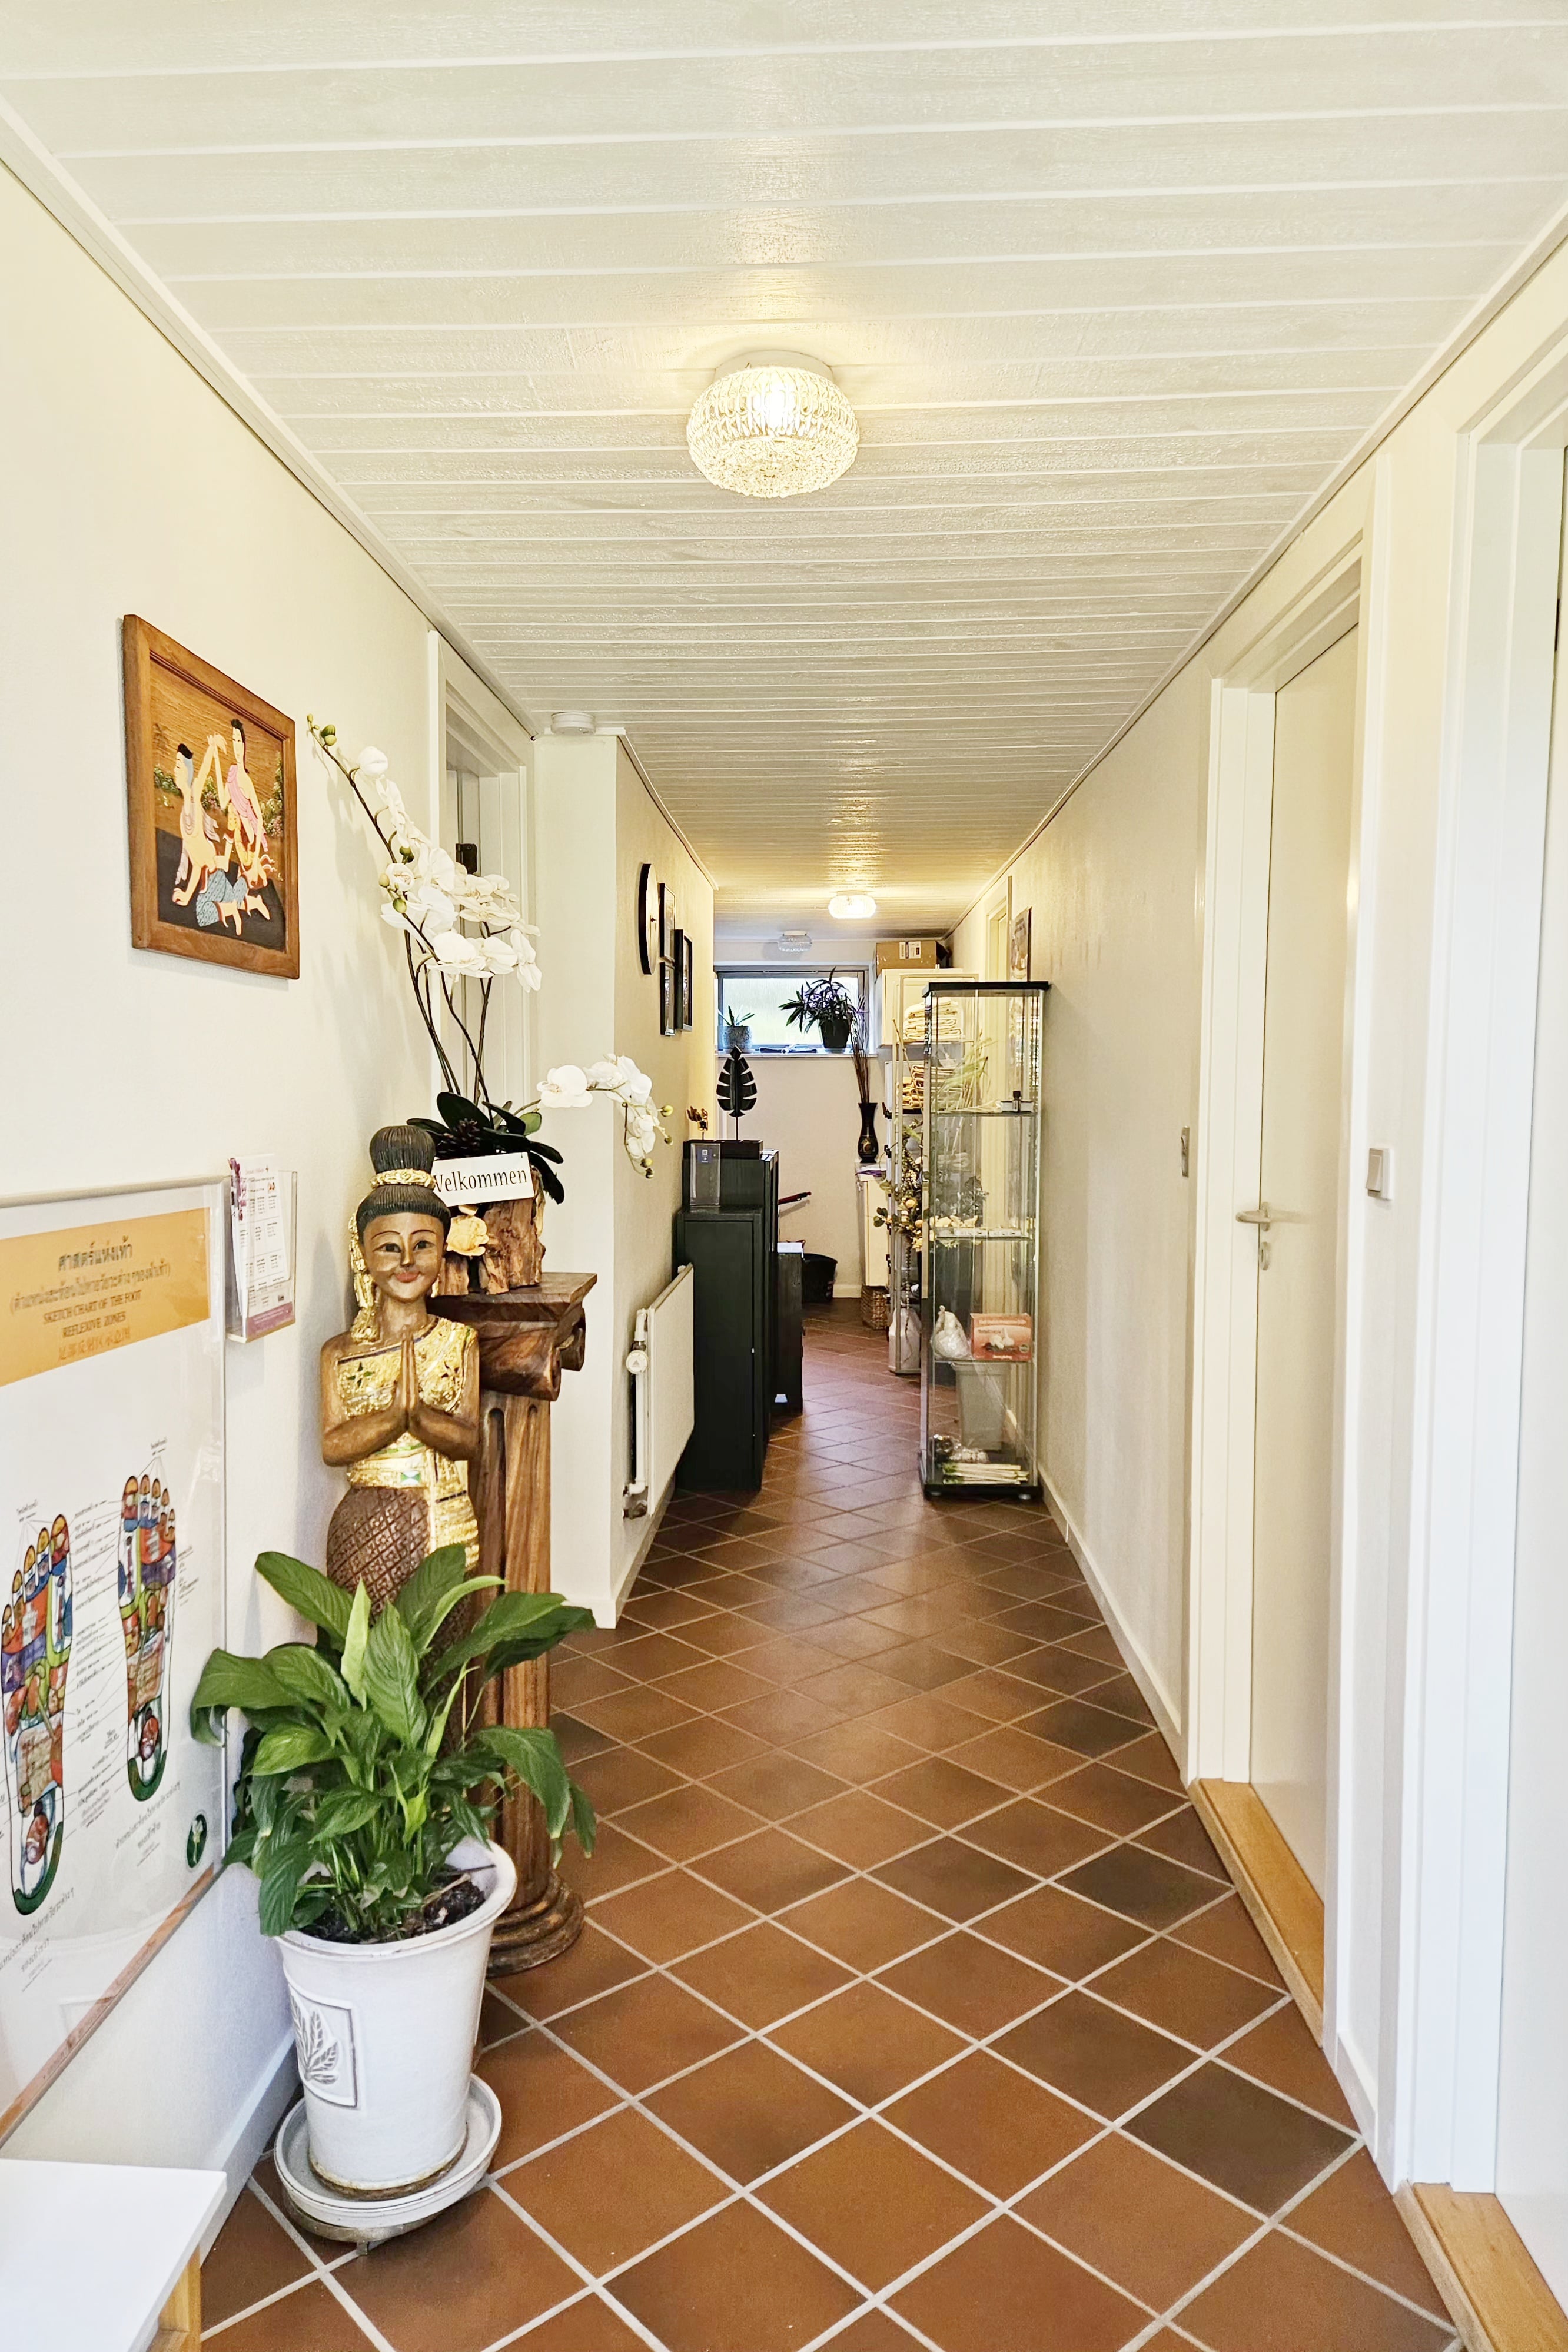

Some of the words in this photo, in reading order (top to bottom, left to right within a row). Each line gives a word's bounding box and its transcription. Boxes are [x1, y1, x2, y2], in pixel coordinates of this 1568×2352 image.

[433, 1170, 527, 1192] Velkommen
[44, 1307, 72, 1324] SKETCH
[74, 1301, 97, 1316] CHART
[98, 1298, 108, 1310] OF
[110, 1294, 123, 1307] THE
[125, 1290, 142, 1303] FOOT
[104, 1311, 127, 1326] ZONES
